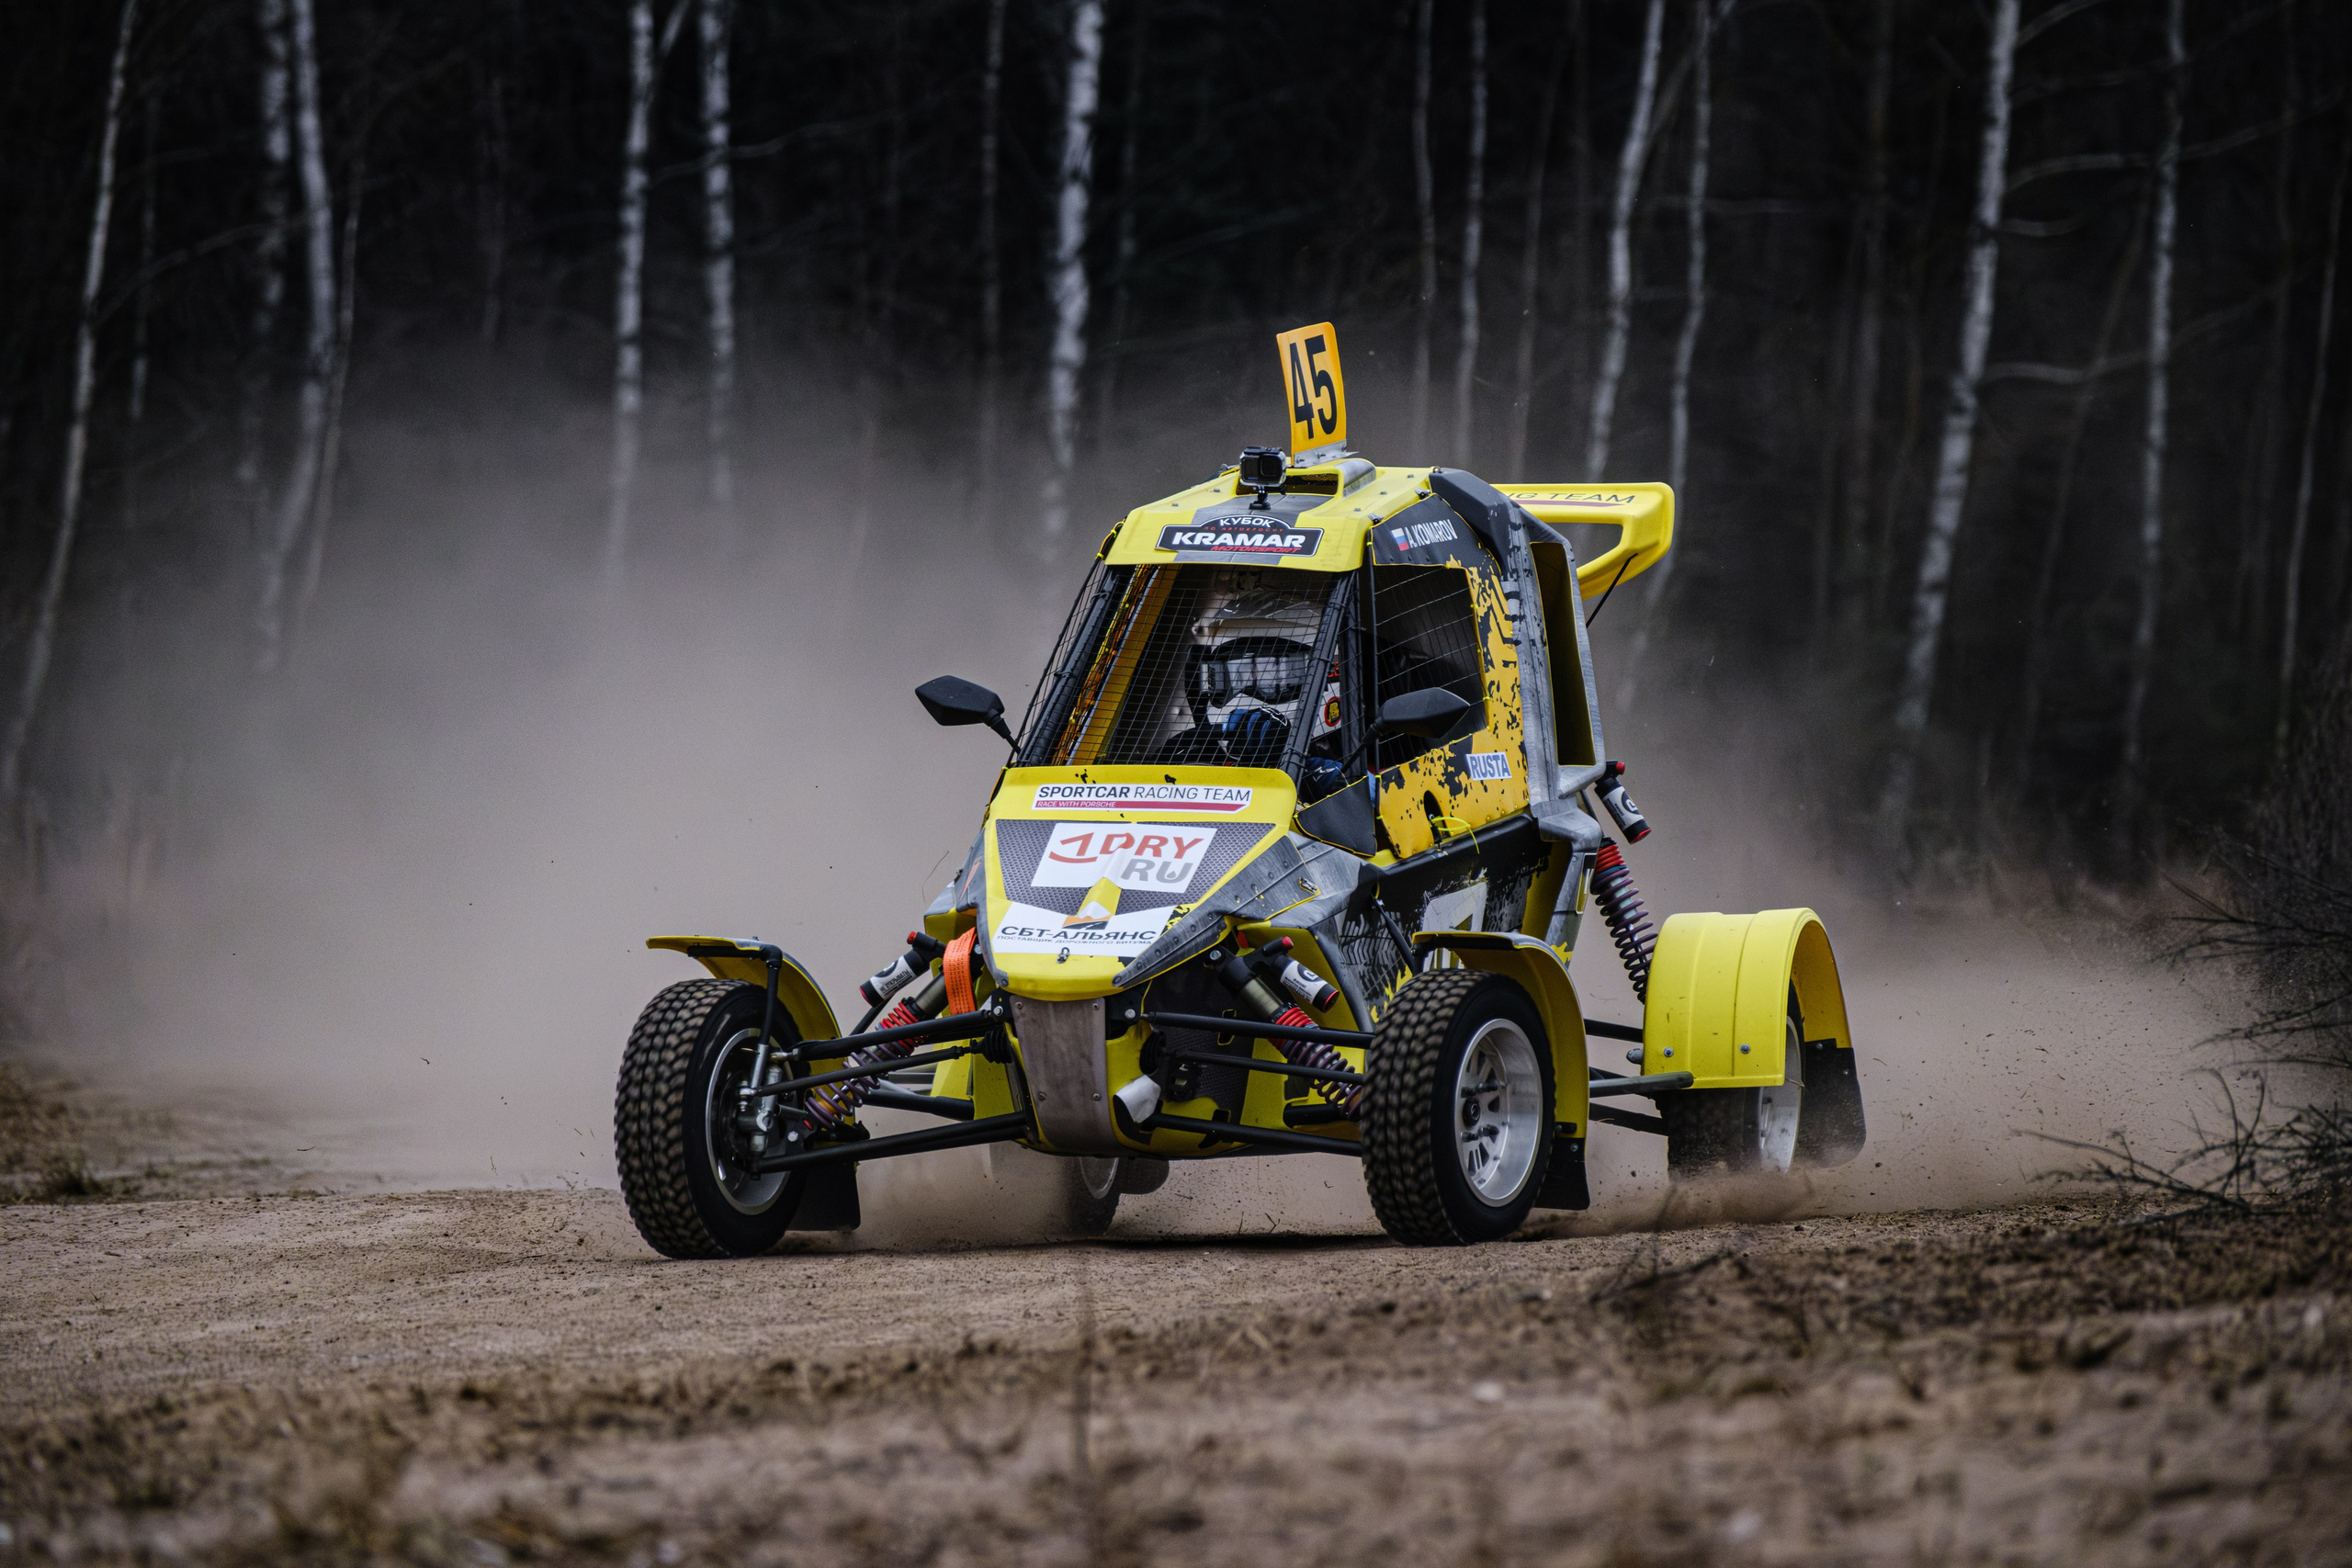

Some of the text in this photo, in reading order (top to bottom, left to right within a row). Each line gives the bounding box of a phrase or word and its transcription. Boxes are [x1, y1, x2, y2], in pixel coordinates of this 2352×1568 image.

[1290, 334, 1337, 439] 45
[1549, 493, 1635, 503] TEAM
[1220, 517, 1274, 527] КУБОК
[1172, 532, 1306, 547] KRAMAR
[1210, 546, 1301, 554] MOTORSPORT
[1470, 754, 1511, 778] RUSTA
[1038, 786, 1250, 802] SPORTCAR RACING TEAM
[997, 935, 1053, 943] ПОСТАВЩИК
[1001, 926, 1157, 941] СБТ-АЛЬЯНС
